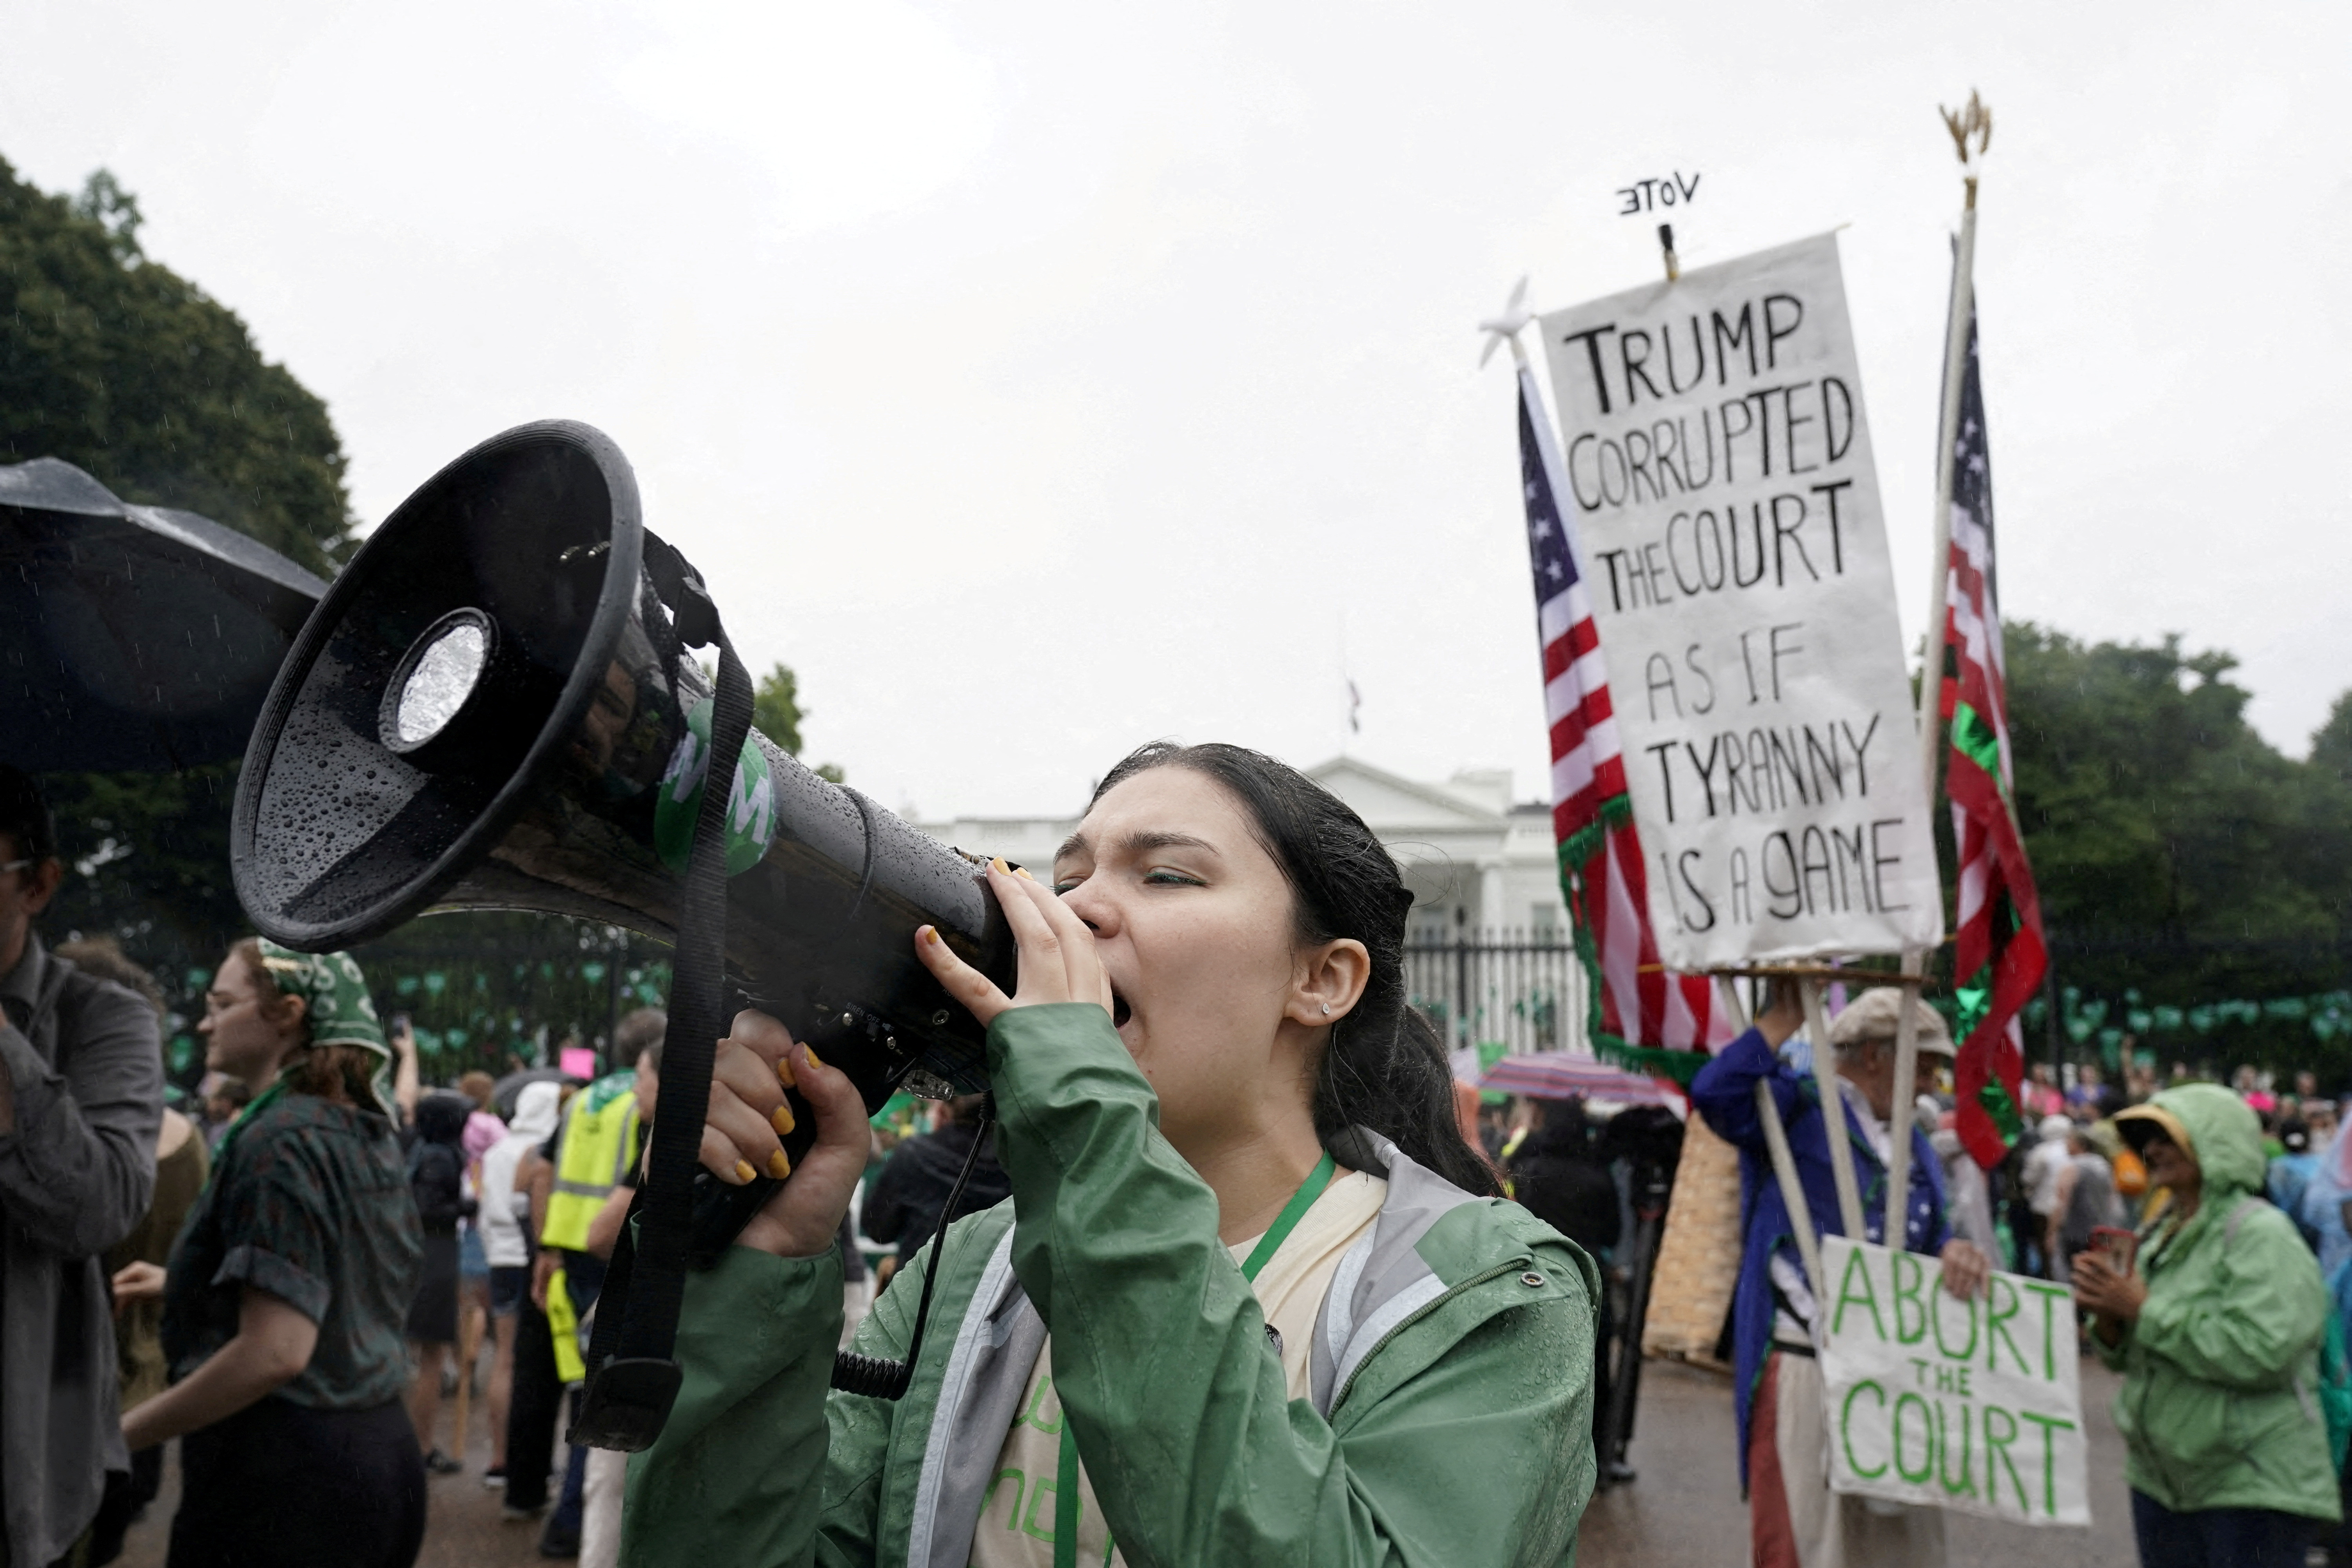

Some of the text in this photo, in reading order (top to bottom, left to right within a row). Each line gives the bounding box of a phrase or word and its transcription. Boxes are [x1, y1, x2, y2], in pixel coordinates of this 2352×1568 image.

[1565, 295, 1802, 414] TRUMP
[1570, 377, 1853, 510] CORRUPTED
[1595, 477, 1853, 612] THE COURT
[1646, 622, 1805, 722] AS IF
[1646, 712, 1880, 824] TYRANNY
[1660, 849, 1715, 935] IS
[1730, 846, 1752, 926] A
[846, 1002, 880, 1024] SIREN OFF
[1835, 1247, 2069, 1379] ABORT
[1908, 1357, 1974, 1398] THE
[1843, 1382, 2074, 1514] COURT
